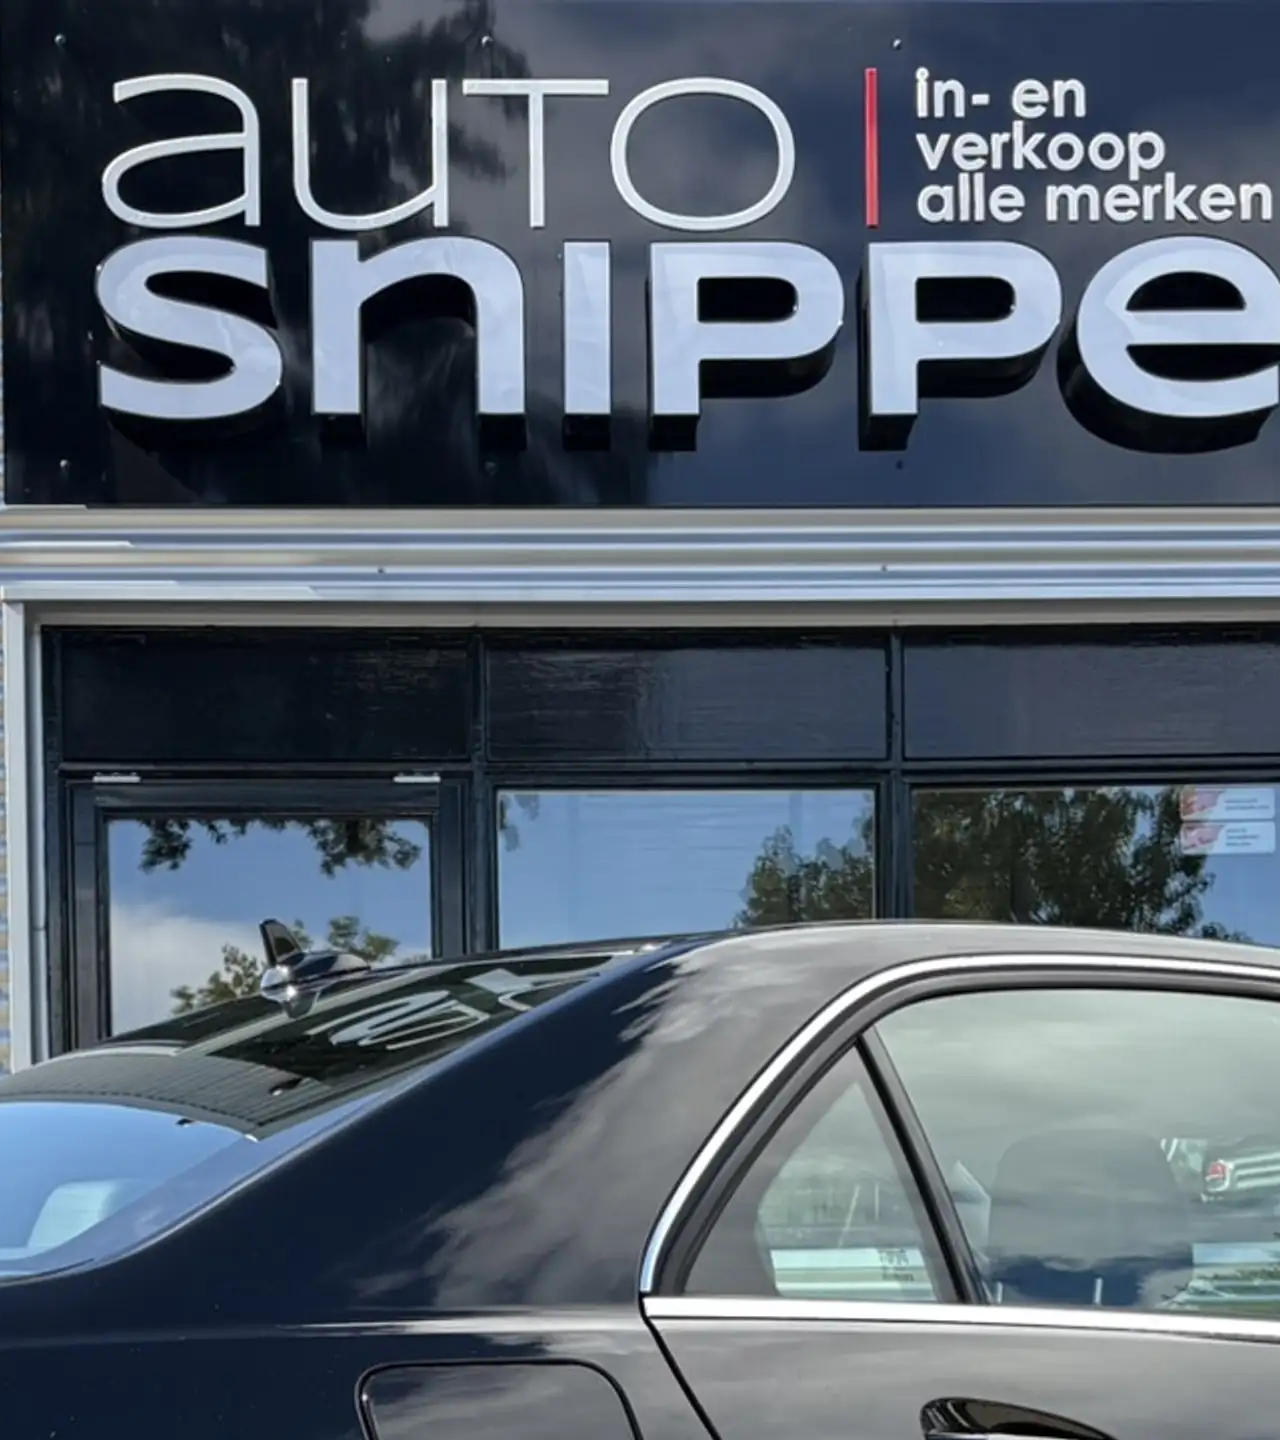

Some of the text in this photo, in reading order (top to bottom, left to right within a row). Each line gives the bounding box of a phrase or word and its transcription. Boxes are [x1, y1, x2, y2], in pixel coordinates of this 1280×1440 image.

[914, 67, 1087, 119] in- en
[915, 119, 1166, 182] verkoop
[916, 171, 1274, 223] alle merken
